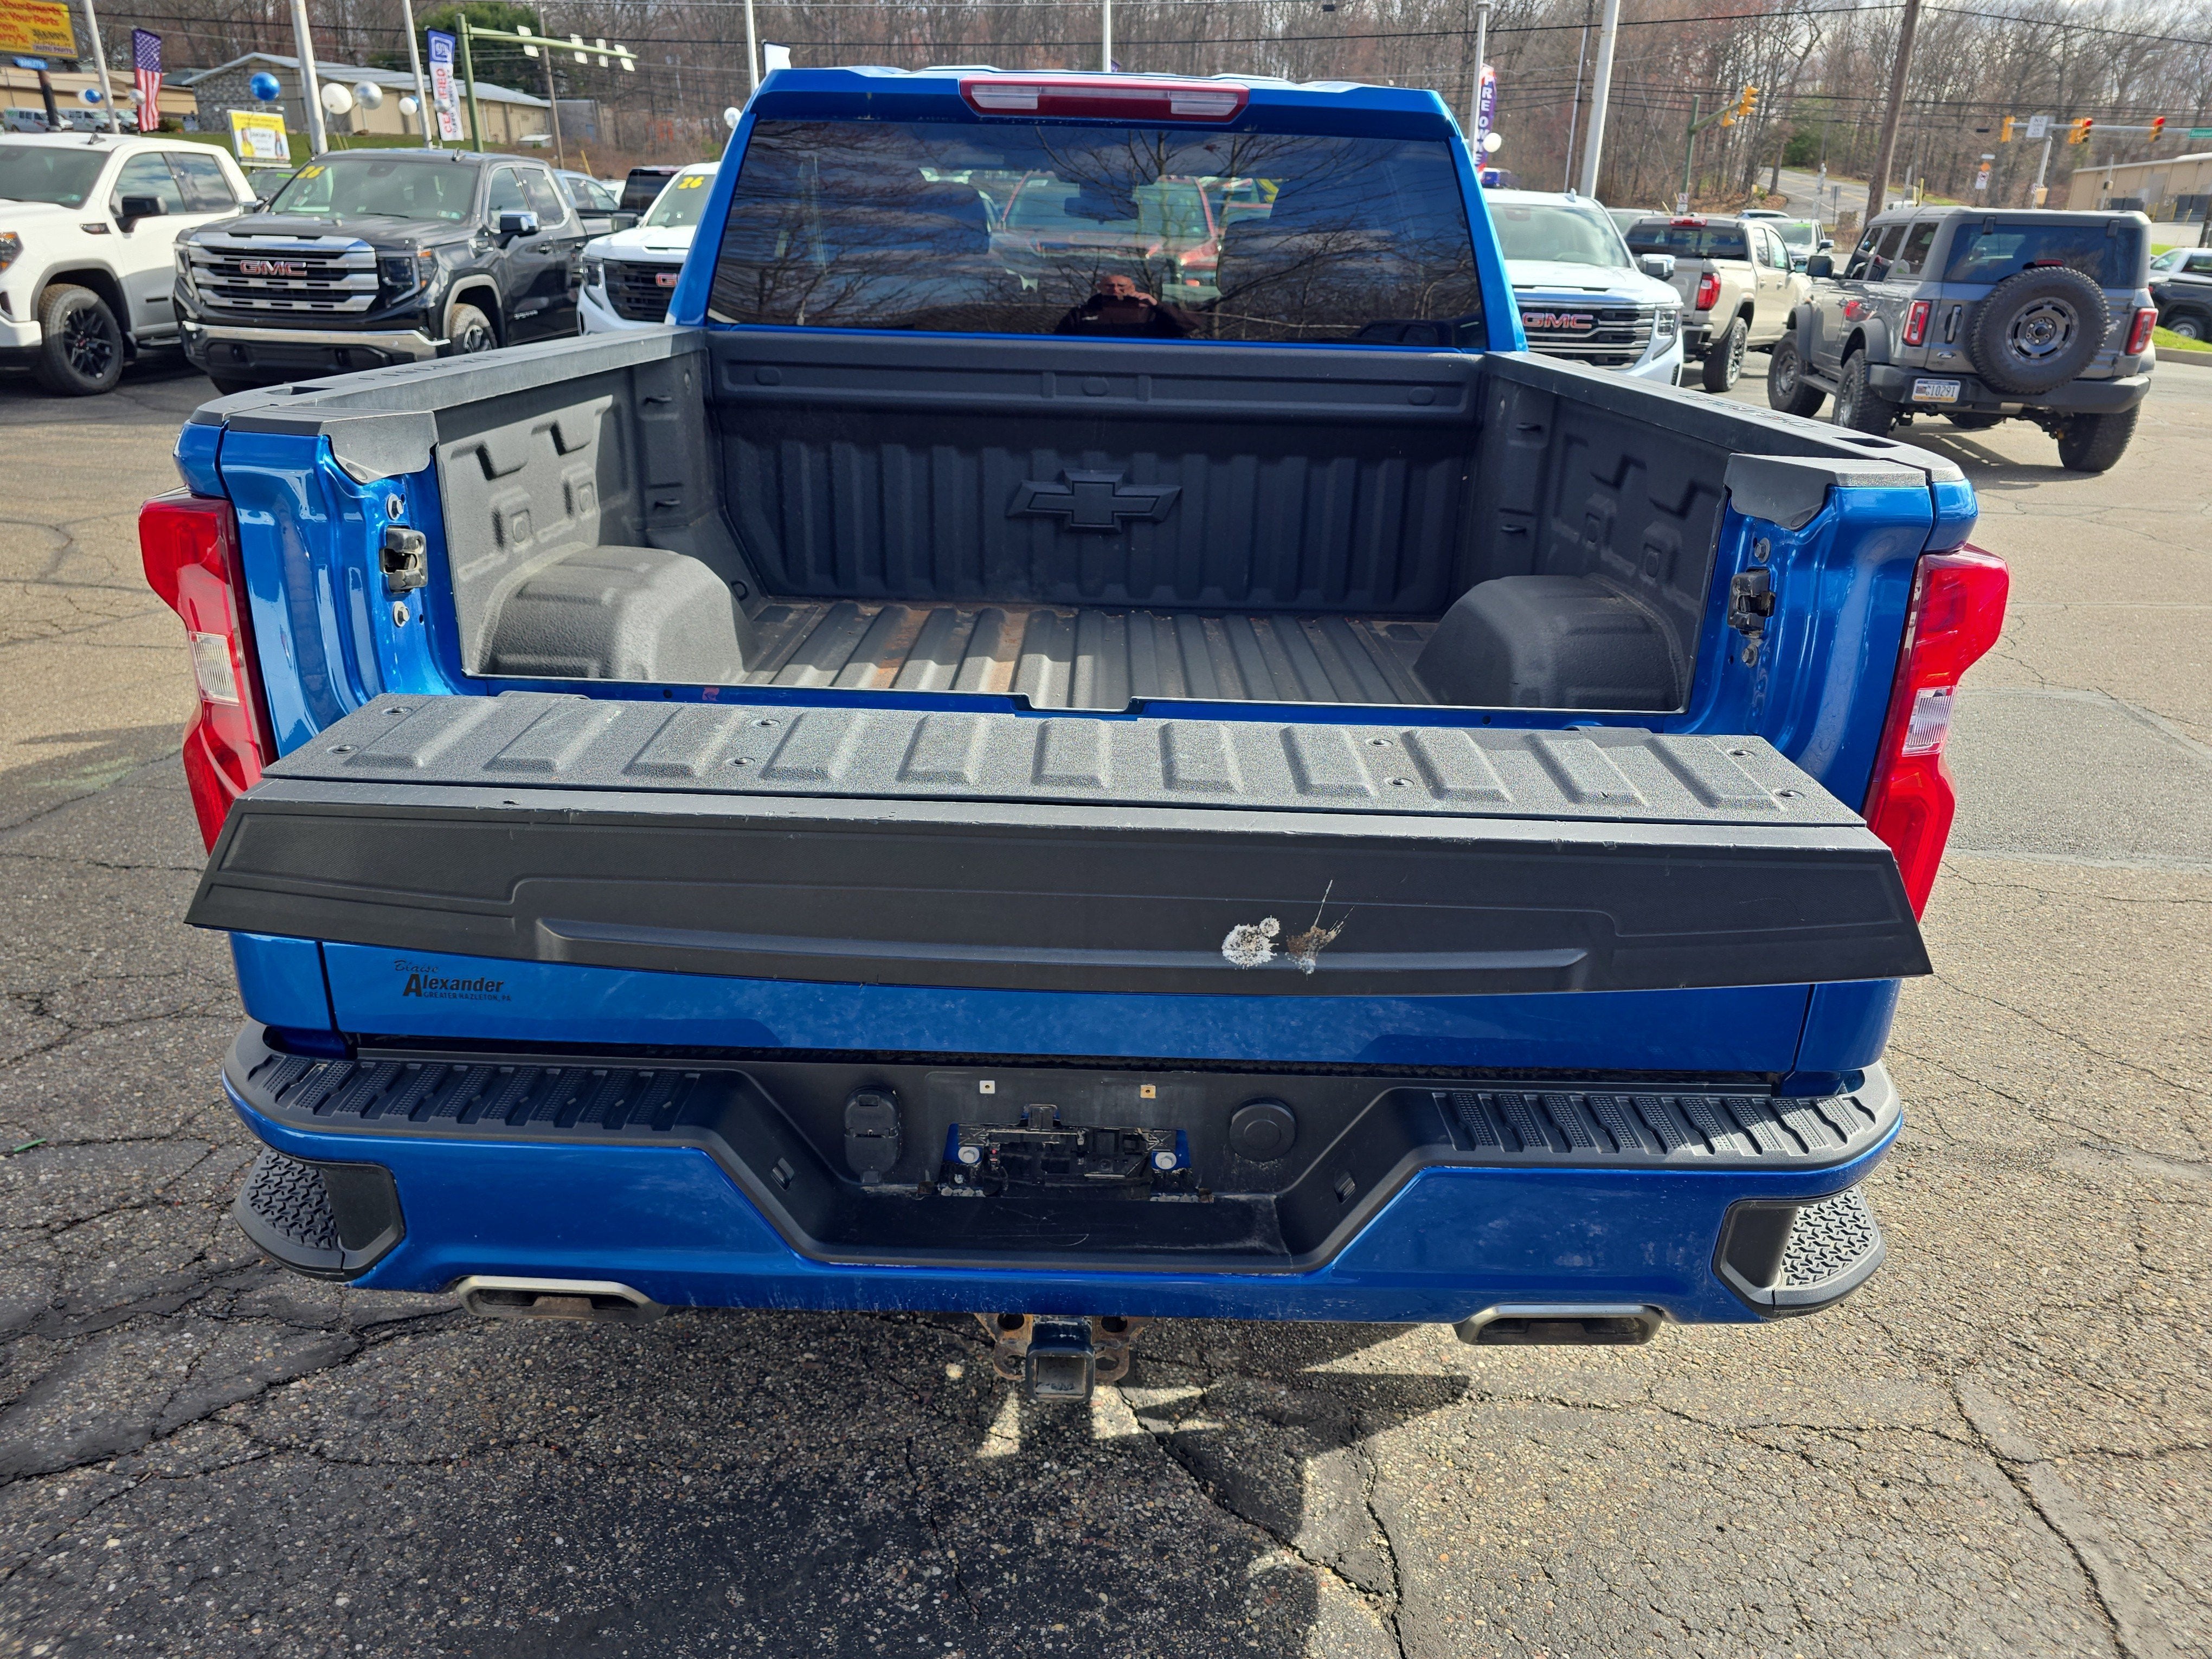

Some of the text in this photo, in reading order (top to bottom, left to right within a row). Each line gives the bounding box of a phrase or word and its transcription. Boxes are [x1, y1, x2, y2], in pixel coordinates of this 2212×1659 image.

[436, 68, 453, 133] CEIFIED
[677, 176, 704, 190] 26
[240, 260, 307, 276] GMC
[1522, 312, 1593, 329] GMC
[394, 960, 439, 973] Blaise
[402, 973, 504, 997] Alexander
[424, 991, 458, 999] GREATER
